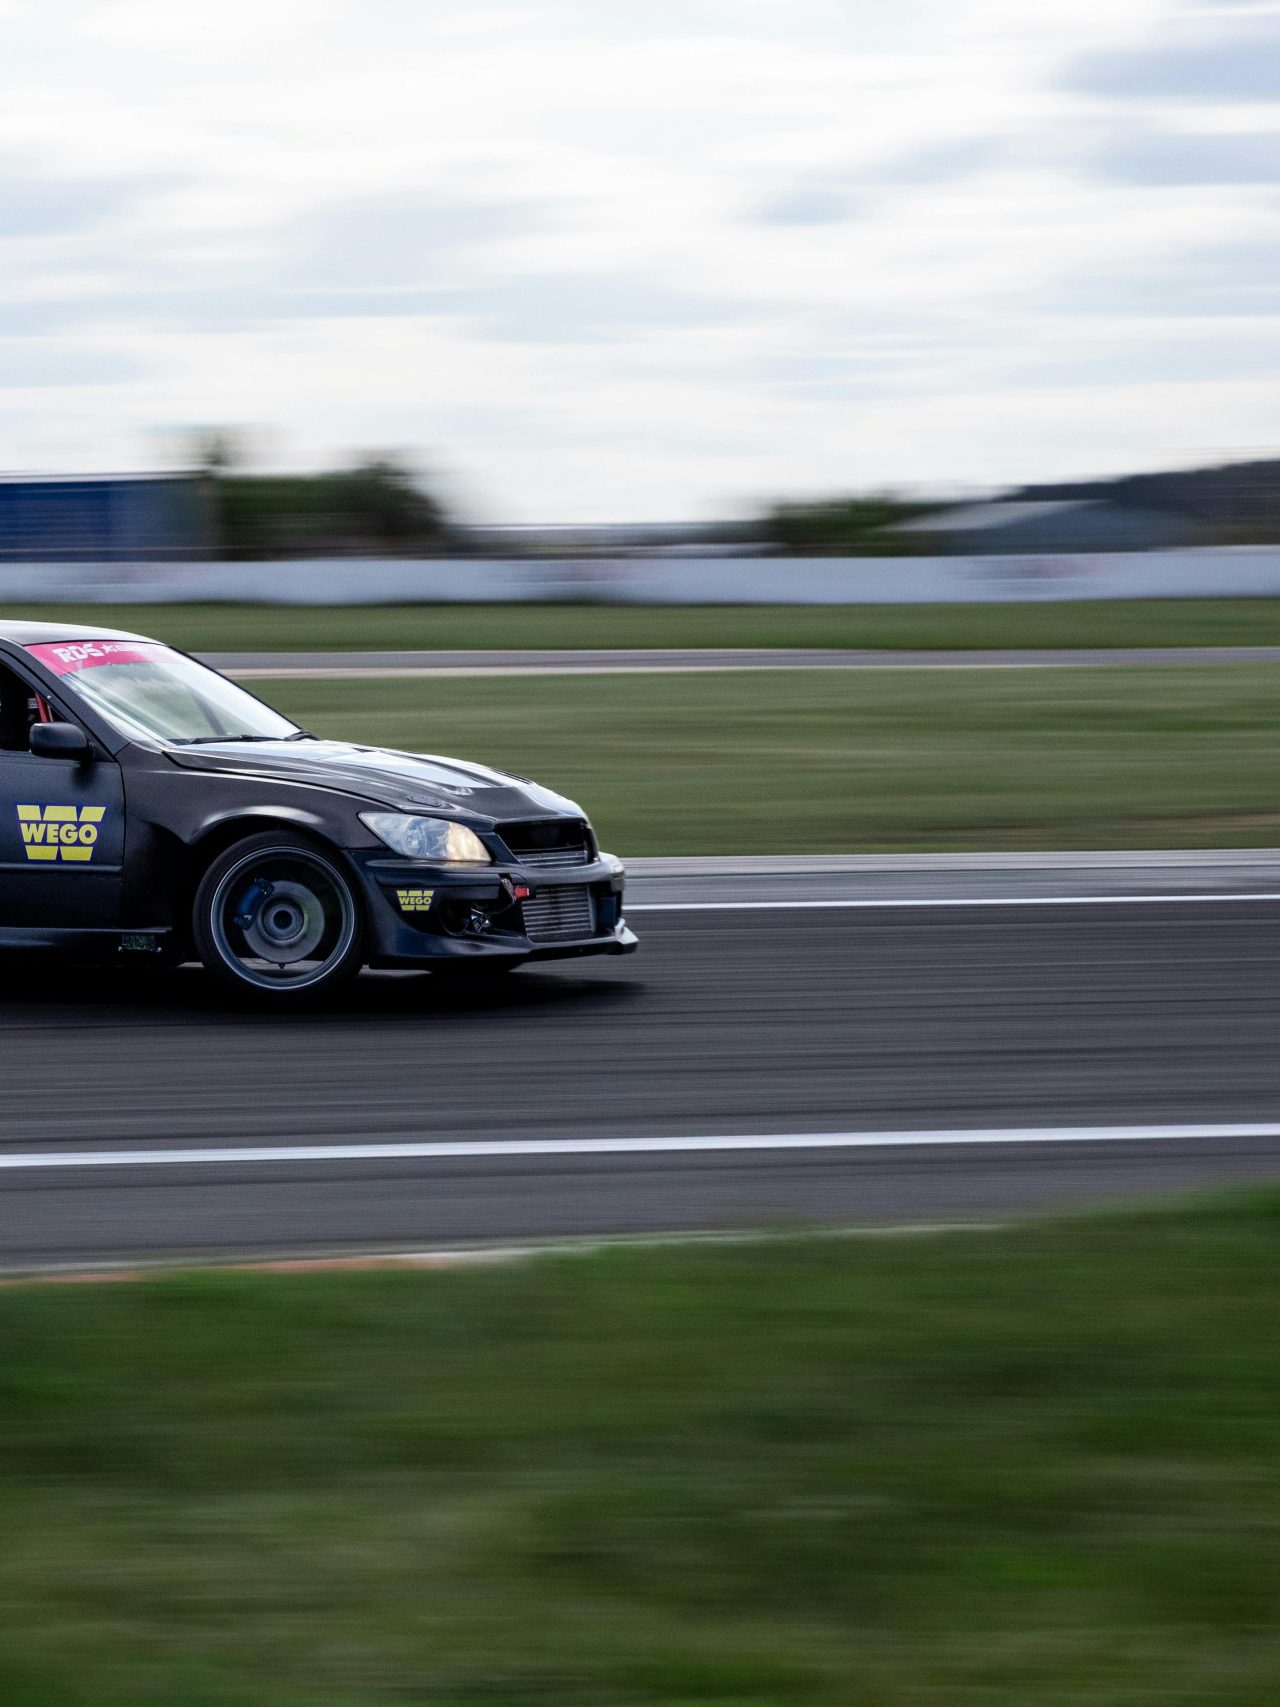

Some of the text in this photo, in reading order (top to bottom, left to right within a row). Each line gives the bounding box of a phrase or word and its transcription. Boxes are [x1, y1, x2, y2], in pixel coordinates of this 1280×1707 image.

[52, 643, 105, 662] RDS
[20, 823, 98, 845] WEGO
[399, 896, 432, 905] WEGO
